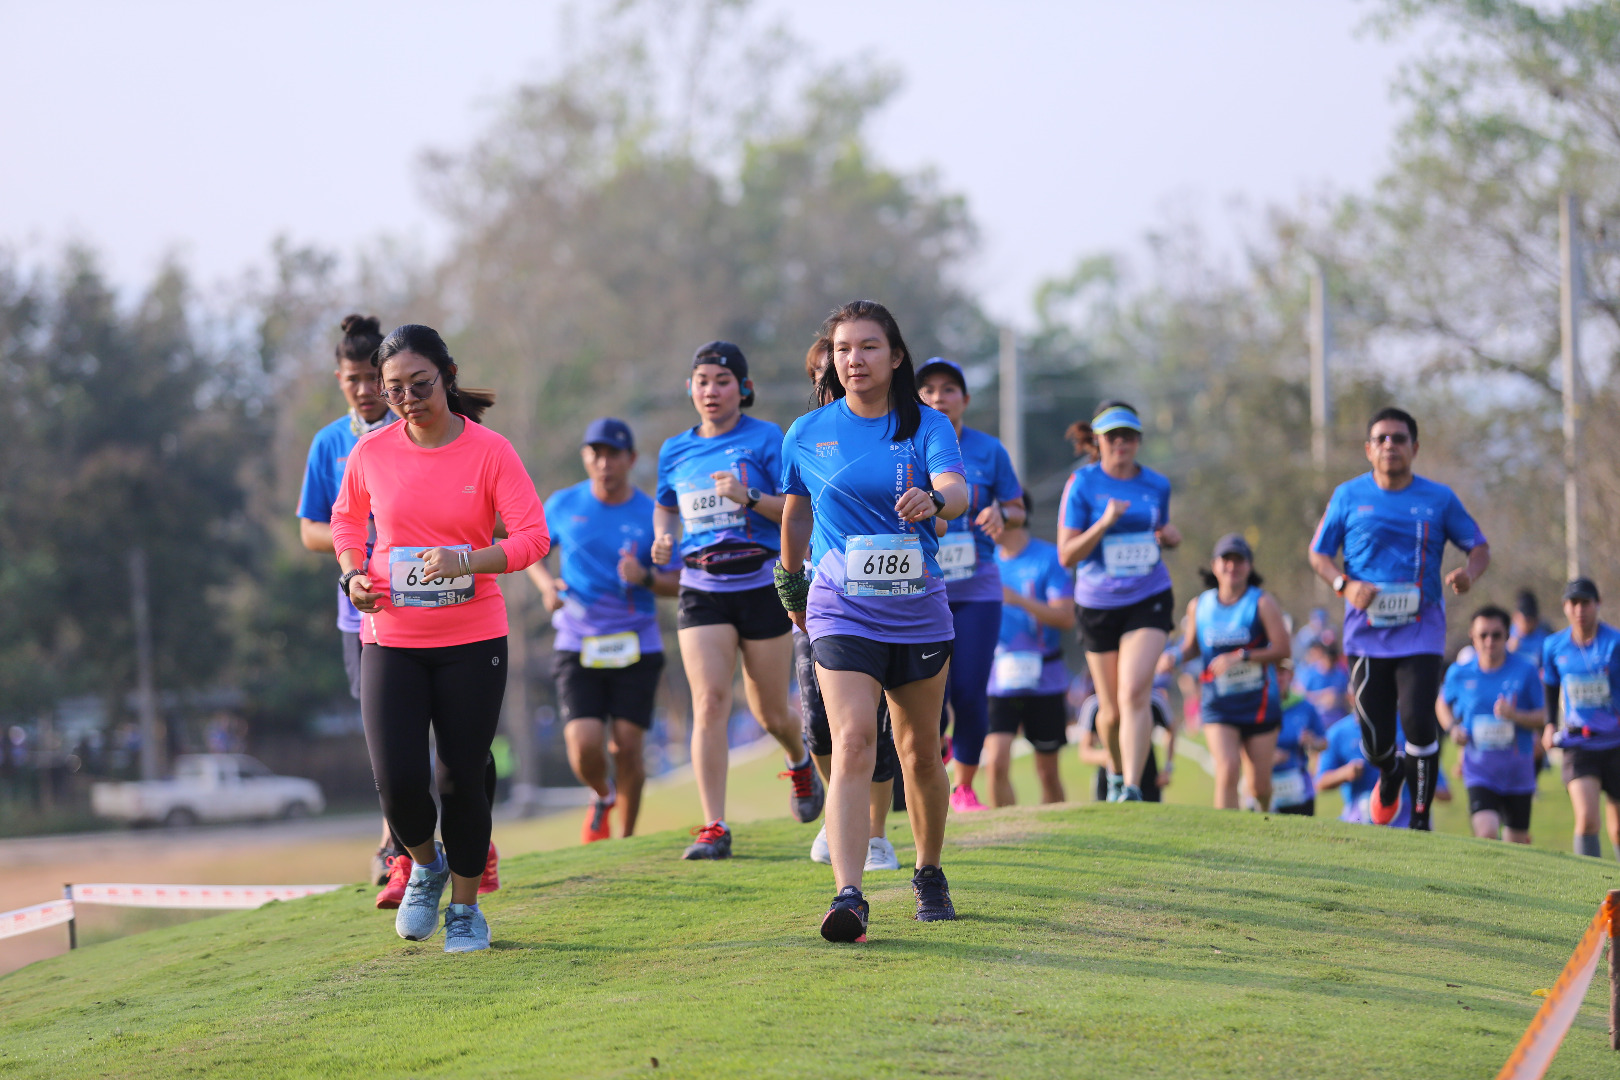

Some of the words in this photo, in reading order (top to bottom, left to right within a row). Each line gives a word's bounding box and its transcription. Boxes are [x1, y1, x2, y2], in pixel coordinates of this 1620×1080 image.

[895, 463, 903, 492] CROSS
[692, 496, 723, 511] 6281
[863, 554, 910, 575] 6186
